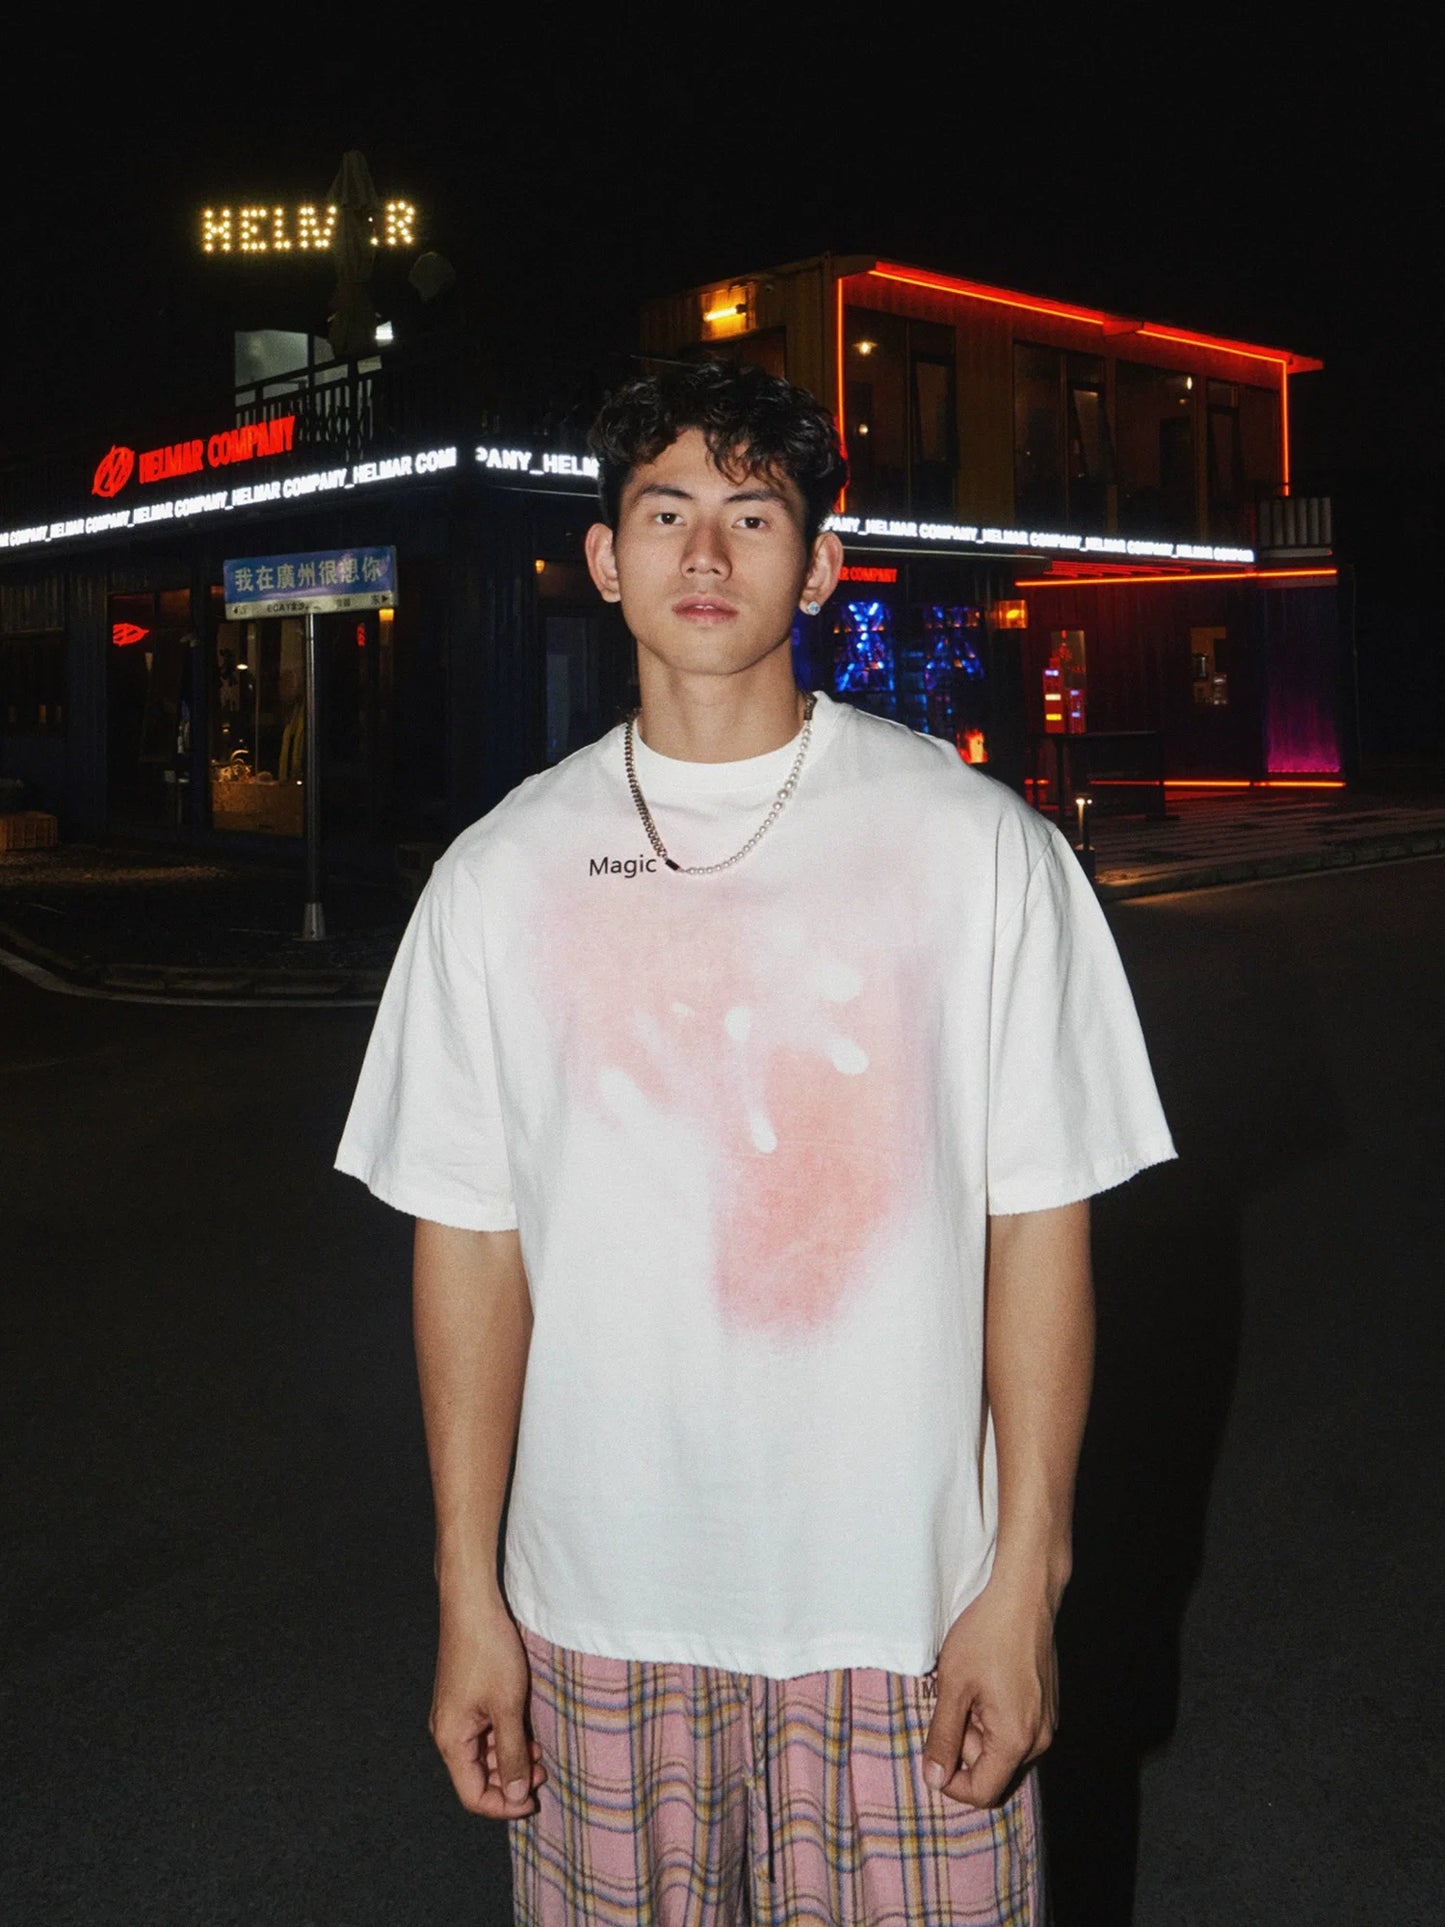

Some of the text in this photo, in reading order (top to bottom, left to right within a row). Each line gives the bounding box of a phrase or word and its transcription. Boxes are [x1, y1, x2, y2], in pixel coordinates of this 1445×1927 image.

[203, 200, 415, 251] HELMR
[138, 415, 296, 484] HELMAR COMPANY
[234, 555, 383, 592] 我在廣州很想你
[589, 854, 657, 878] Magic
